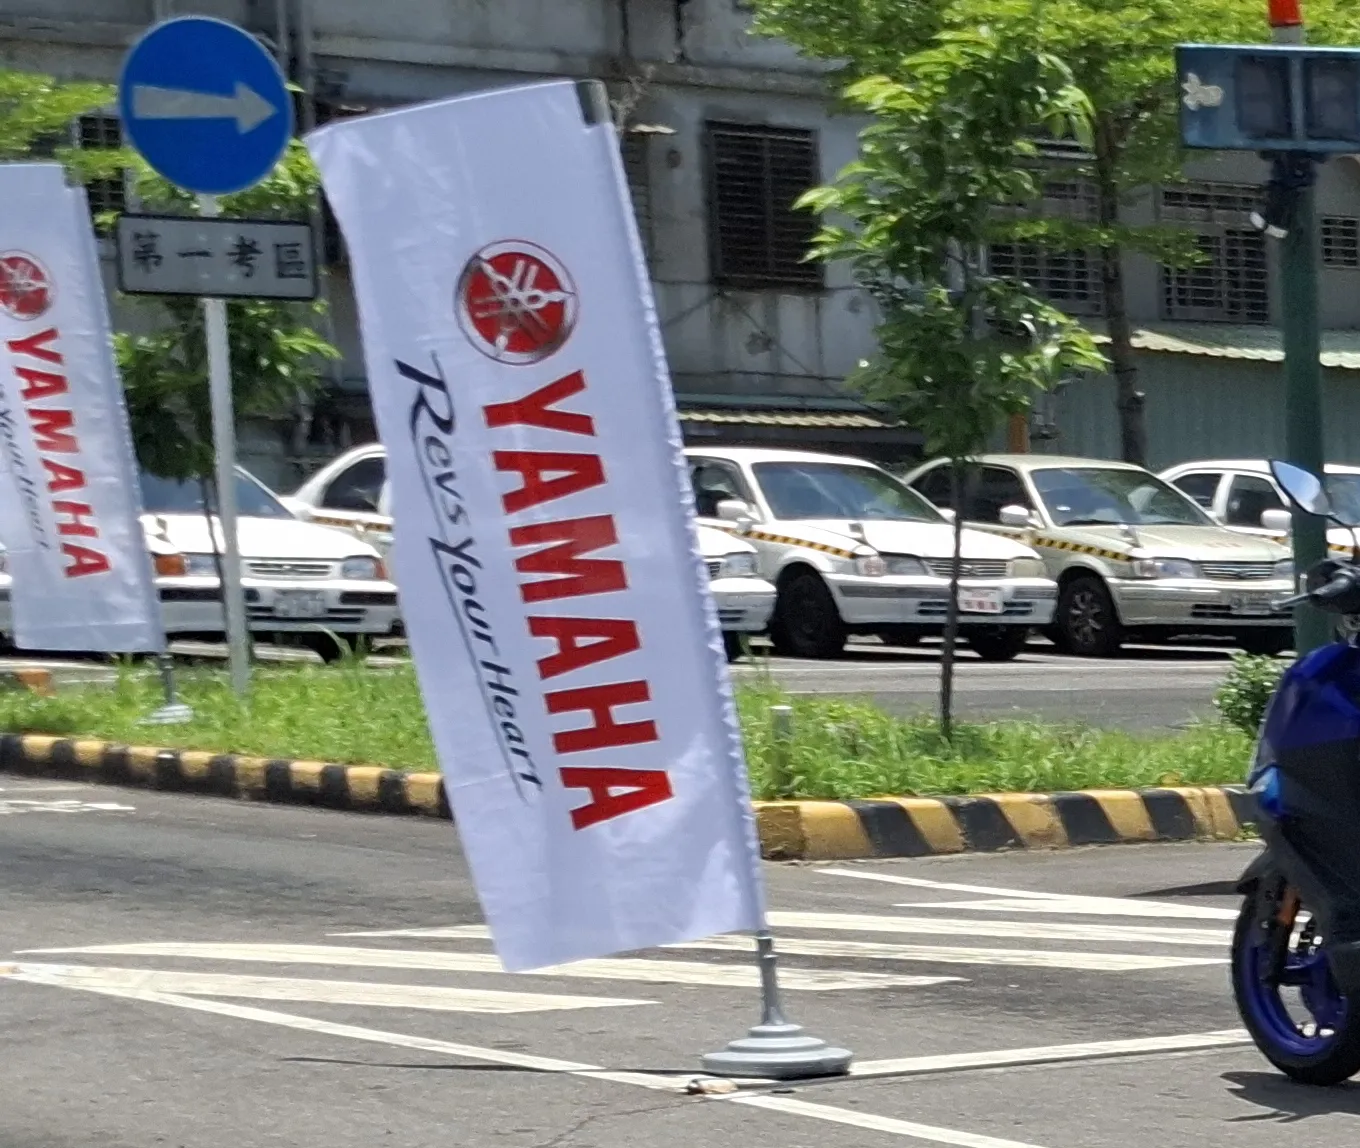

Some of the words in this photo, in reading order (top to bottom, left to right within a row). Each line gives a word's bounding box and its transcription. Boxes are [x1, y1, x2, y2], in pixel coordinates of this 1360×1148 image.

[131, 230, 308, 279] 第一考區
[6, 328, 113, 579] YAMAHA
[394, 350, 471, 527] Revs
[429, 535, 500, 659] Your
[481, 369, 675, 831] YAMAHA
[480, 658, 544, 795] Heart
